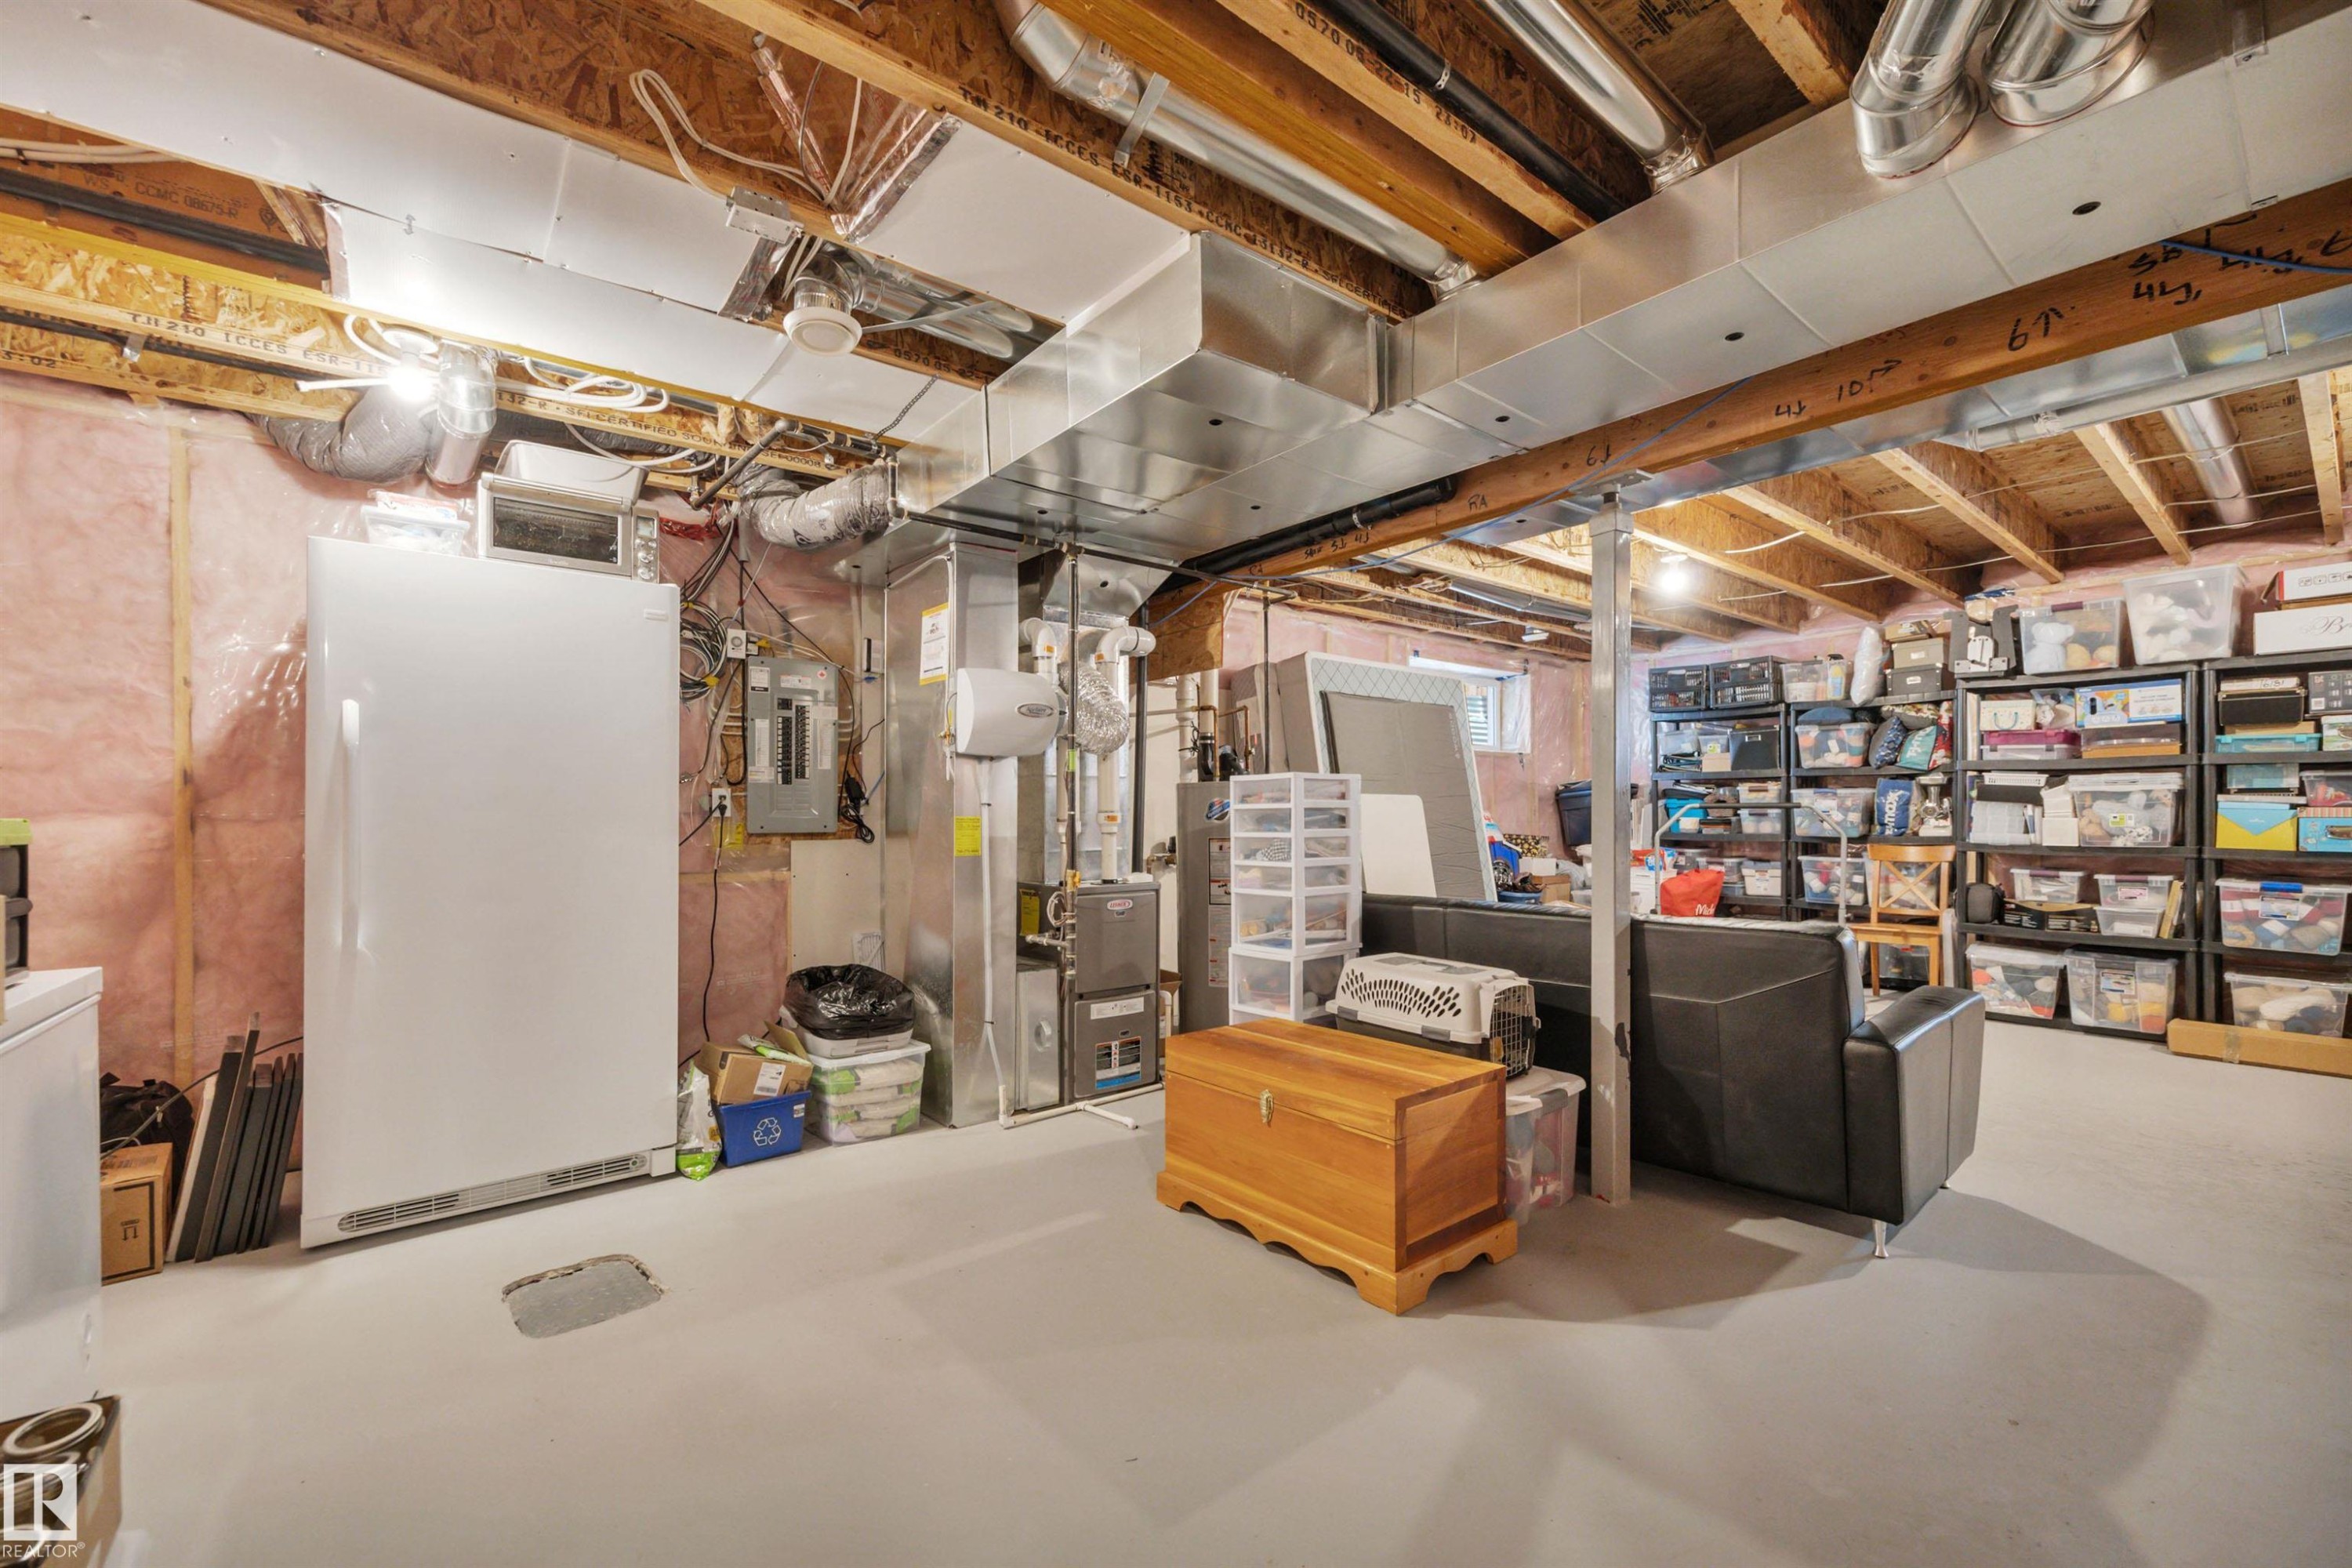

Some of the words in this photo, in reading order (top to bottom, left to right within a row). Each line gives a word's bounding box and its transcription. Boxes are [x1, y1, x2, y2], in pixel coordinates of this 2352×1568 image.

[135, 181, 179, 204] CCMC
[165, 321, 205, 338] 210
[223, 332, 289, 355] ICCES
[303, 349, 390, 376] ESR-115
